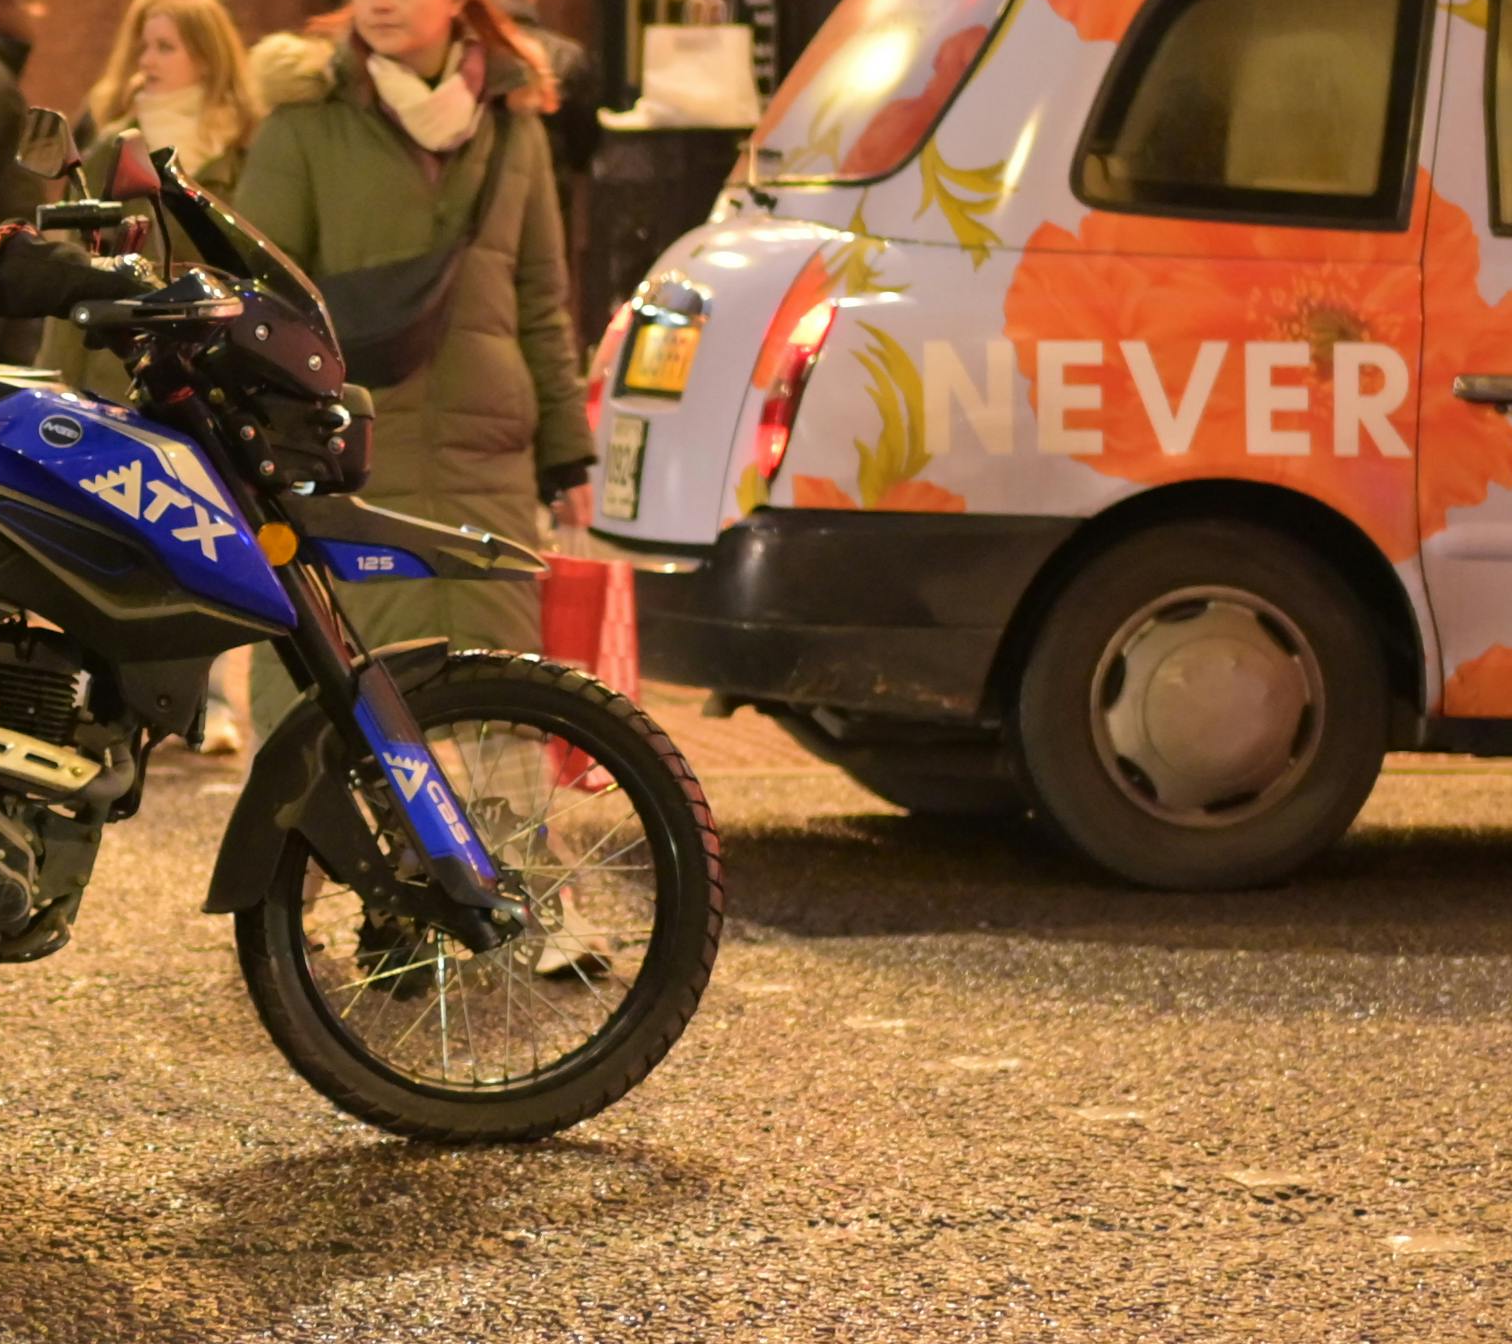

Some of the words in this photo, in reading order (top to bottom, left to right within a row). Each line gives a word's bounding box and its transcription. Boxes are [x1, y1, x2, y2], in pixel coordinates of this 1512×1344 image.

[922, 339, 1413, 457] NEVER
[78, 459, 238, 563] ATX
[357, 556, 395, 571] 125
[427, 780, 471, 845] CBS
